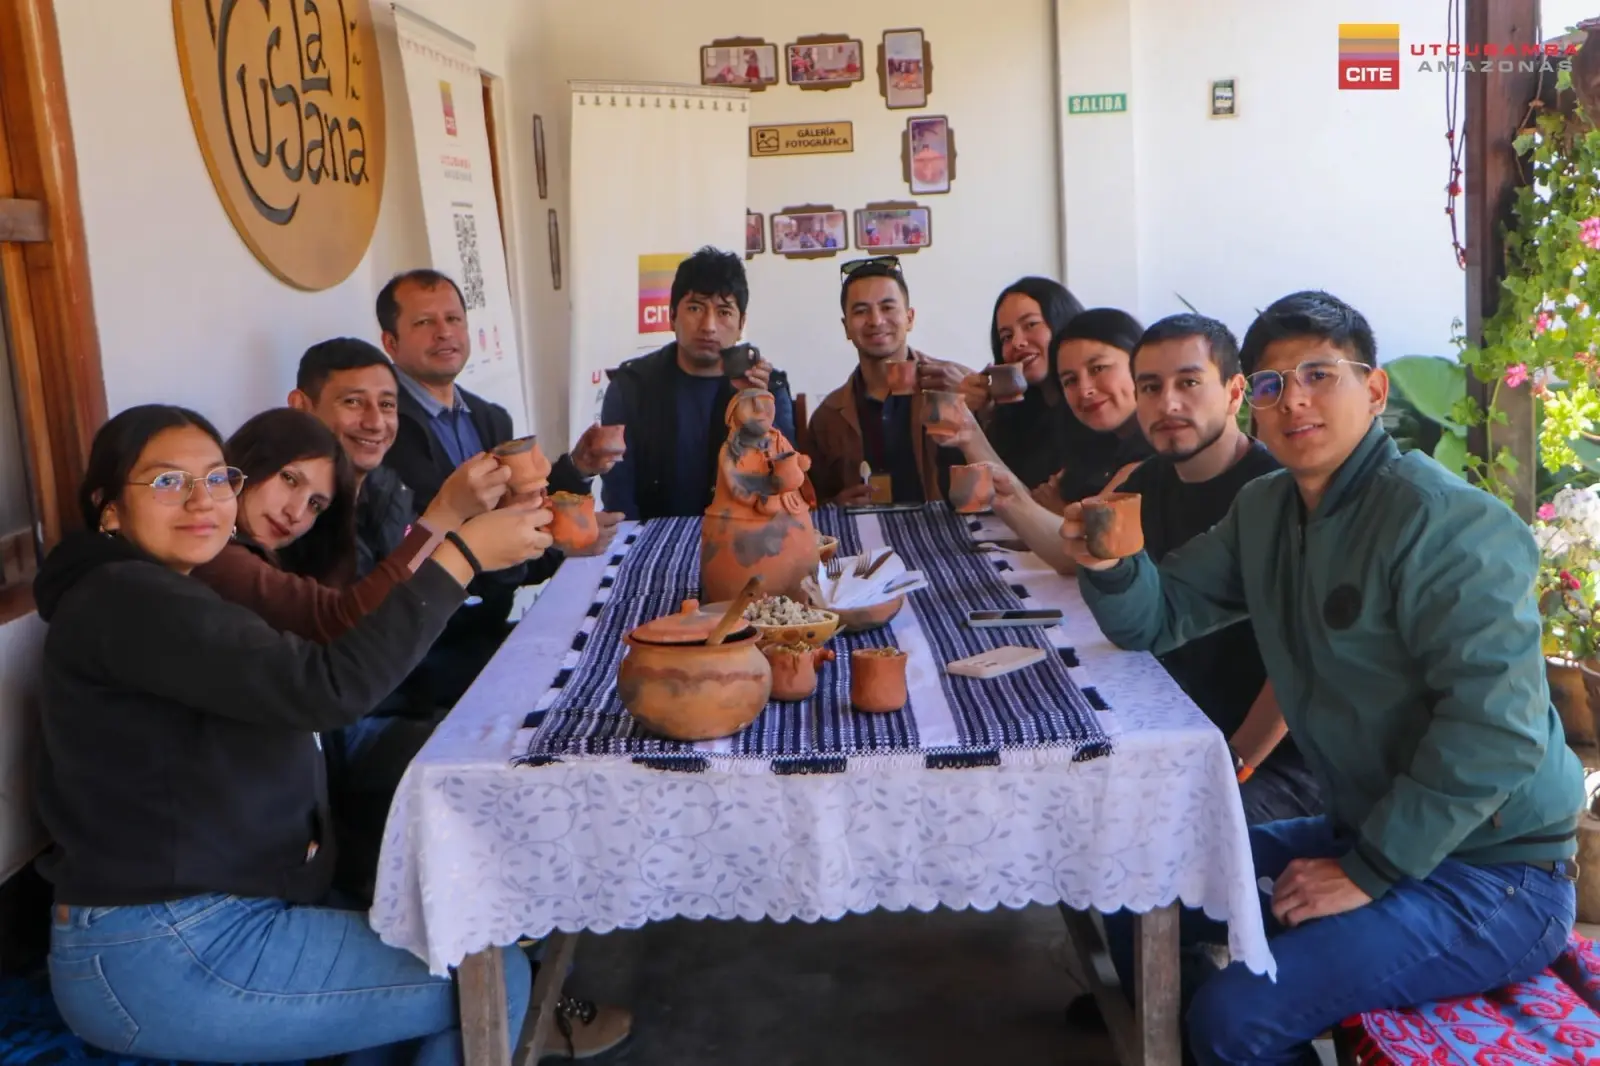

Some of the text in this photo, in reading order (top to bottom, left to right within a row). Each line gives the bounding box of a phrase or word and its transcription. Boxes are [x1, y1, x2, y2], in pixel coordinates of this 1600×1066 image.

[1071, 95, 1123, 112] SALIDA
[797, 126, 836, 138] GALERÍA
[785, 137, 848, 148] FOTOGRÁFICA
[643, 305, 670, 324] CIT
